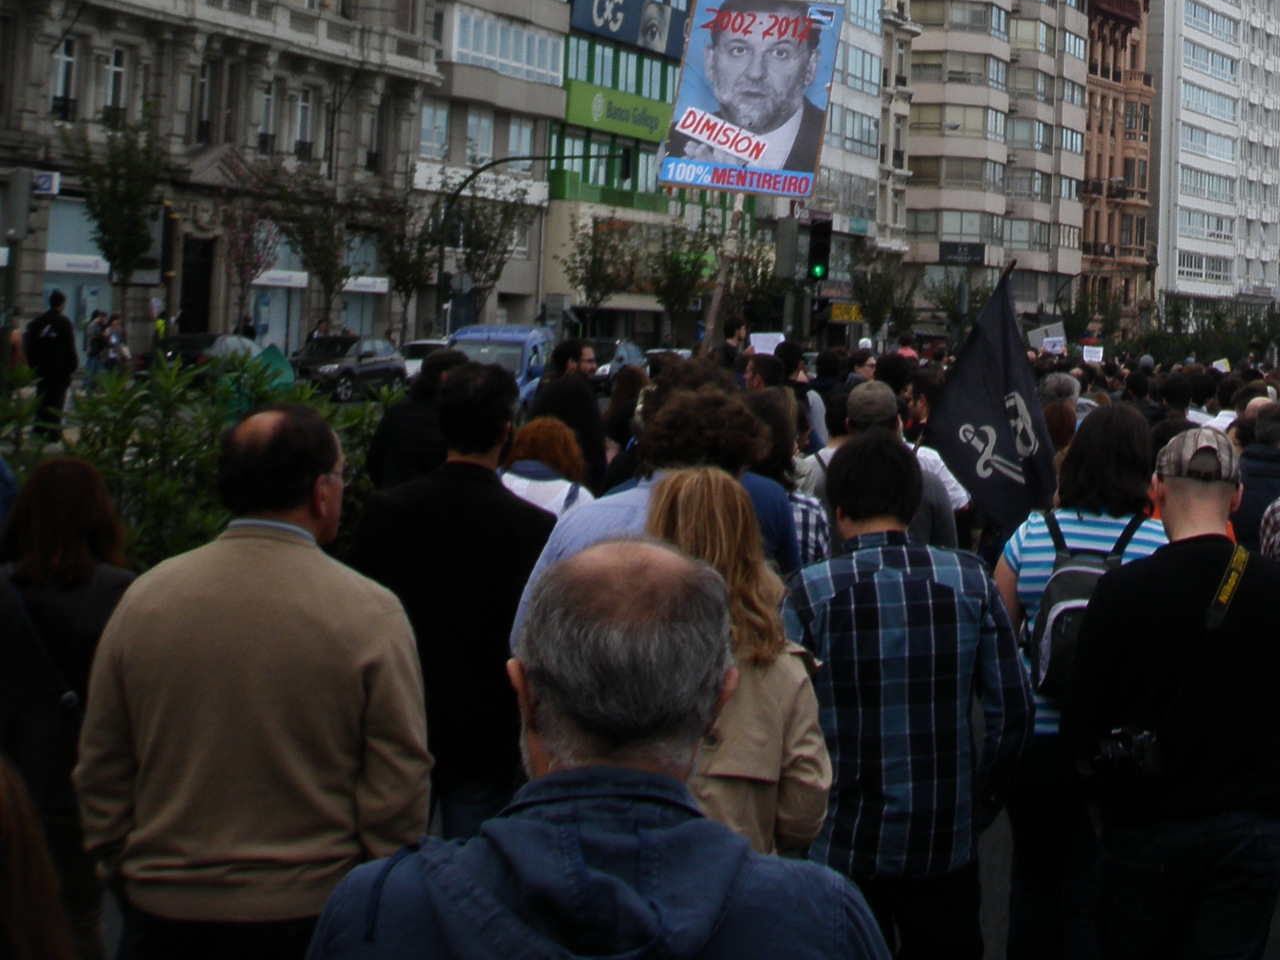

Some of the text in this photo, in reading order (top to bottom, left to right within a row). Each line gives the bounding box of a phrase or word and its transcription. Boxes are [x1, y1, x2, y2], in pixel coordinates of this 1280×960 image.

[606, 100, 660, 134] Banco Gallego
[667, 162, 811, 195] 100% MENTIREIRO
[1218, 570, 1239, 605] Nikon
